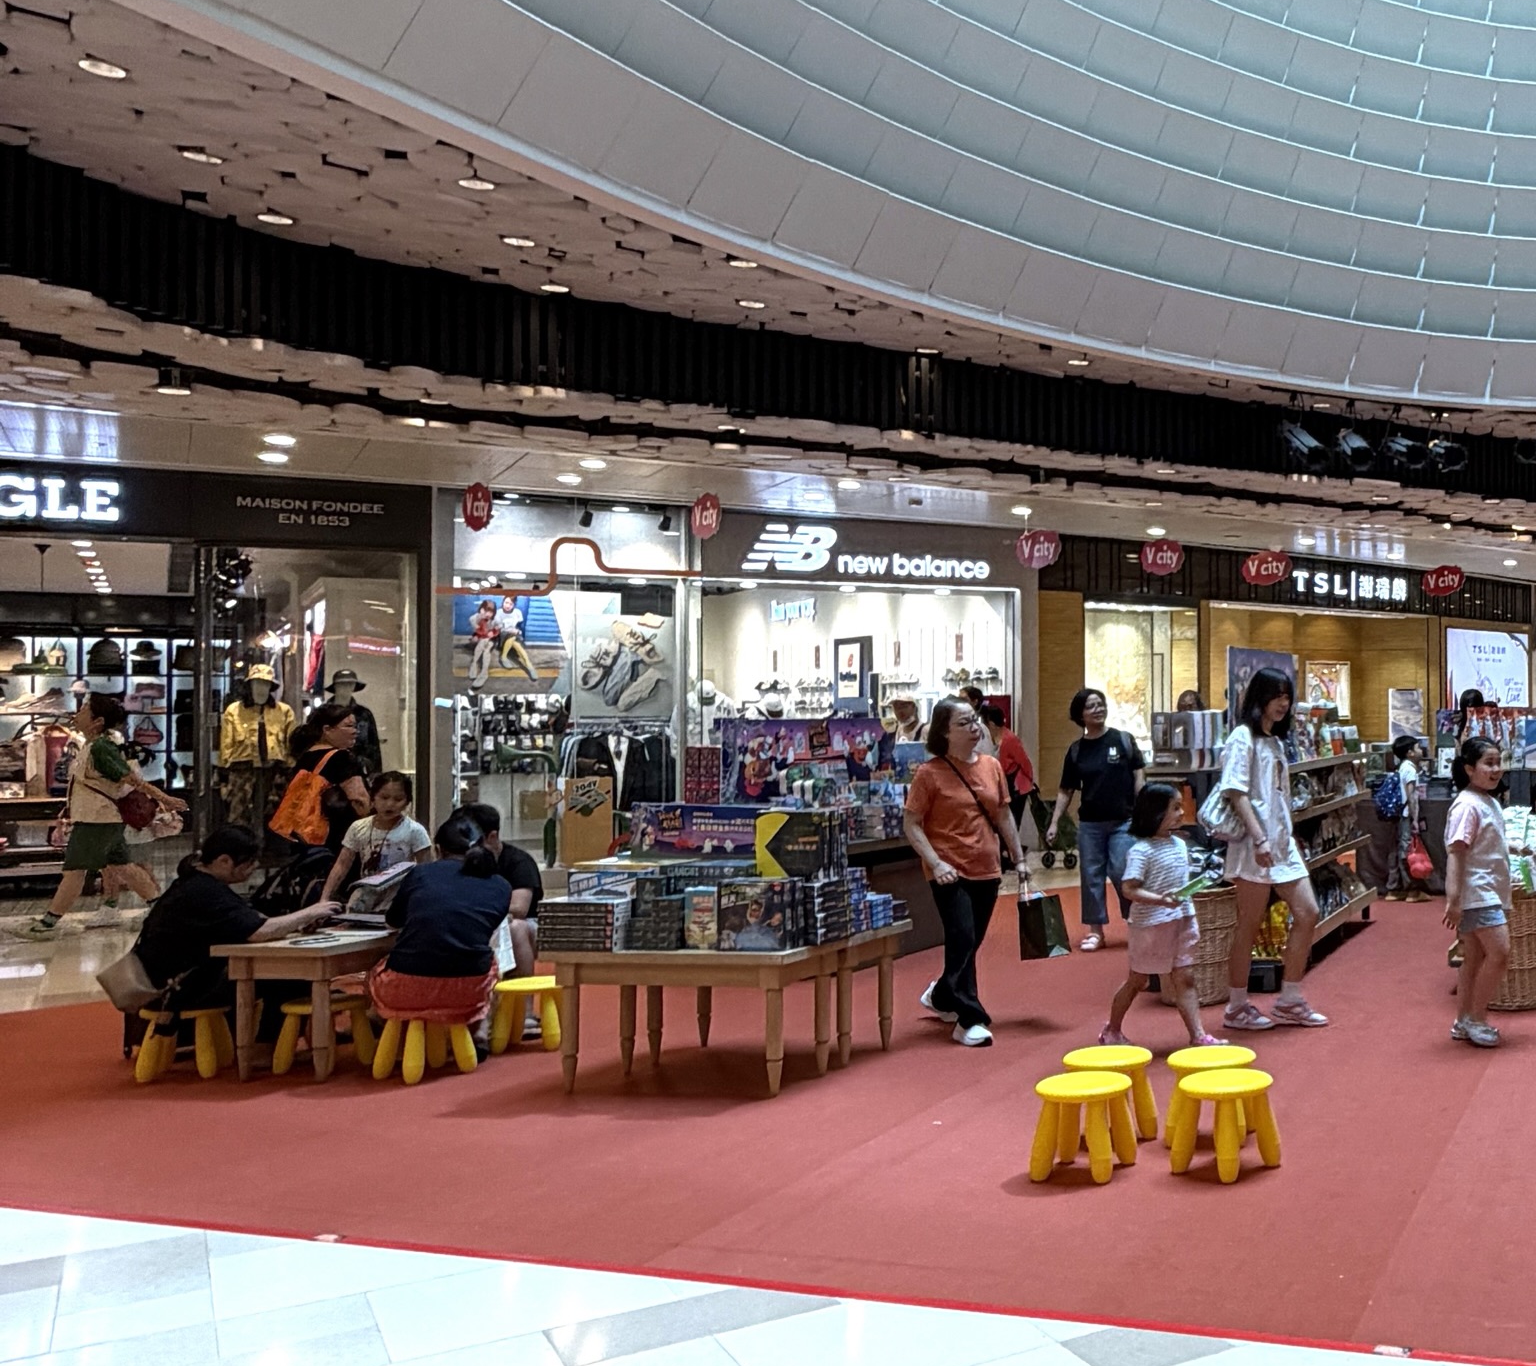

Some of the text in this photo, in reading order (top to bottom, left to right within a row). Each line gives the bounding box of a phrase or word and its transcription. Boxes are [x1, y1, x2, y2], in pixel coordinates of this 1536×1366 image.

[236, 496, 384, 515] MAISON FONDEE
[466, 492, 489, 522] V city
[694, 502, 718, 527] V city
[278, 513, 350, 527] EN 1853
[1022, 537, 1056, 559] V city
[1146, 545, 1179, 568] V city
[837, 552, 991, 579] new balance
[1248, 558, 1286, 577] V city
[1292, 570, 1348, 596] TSL
[1428, 571, 1460, 588] V city
